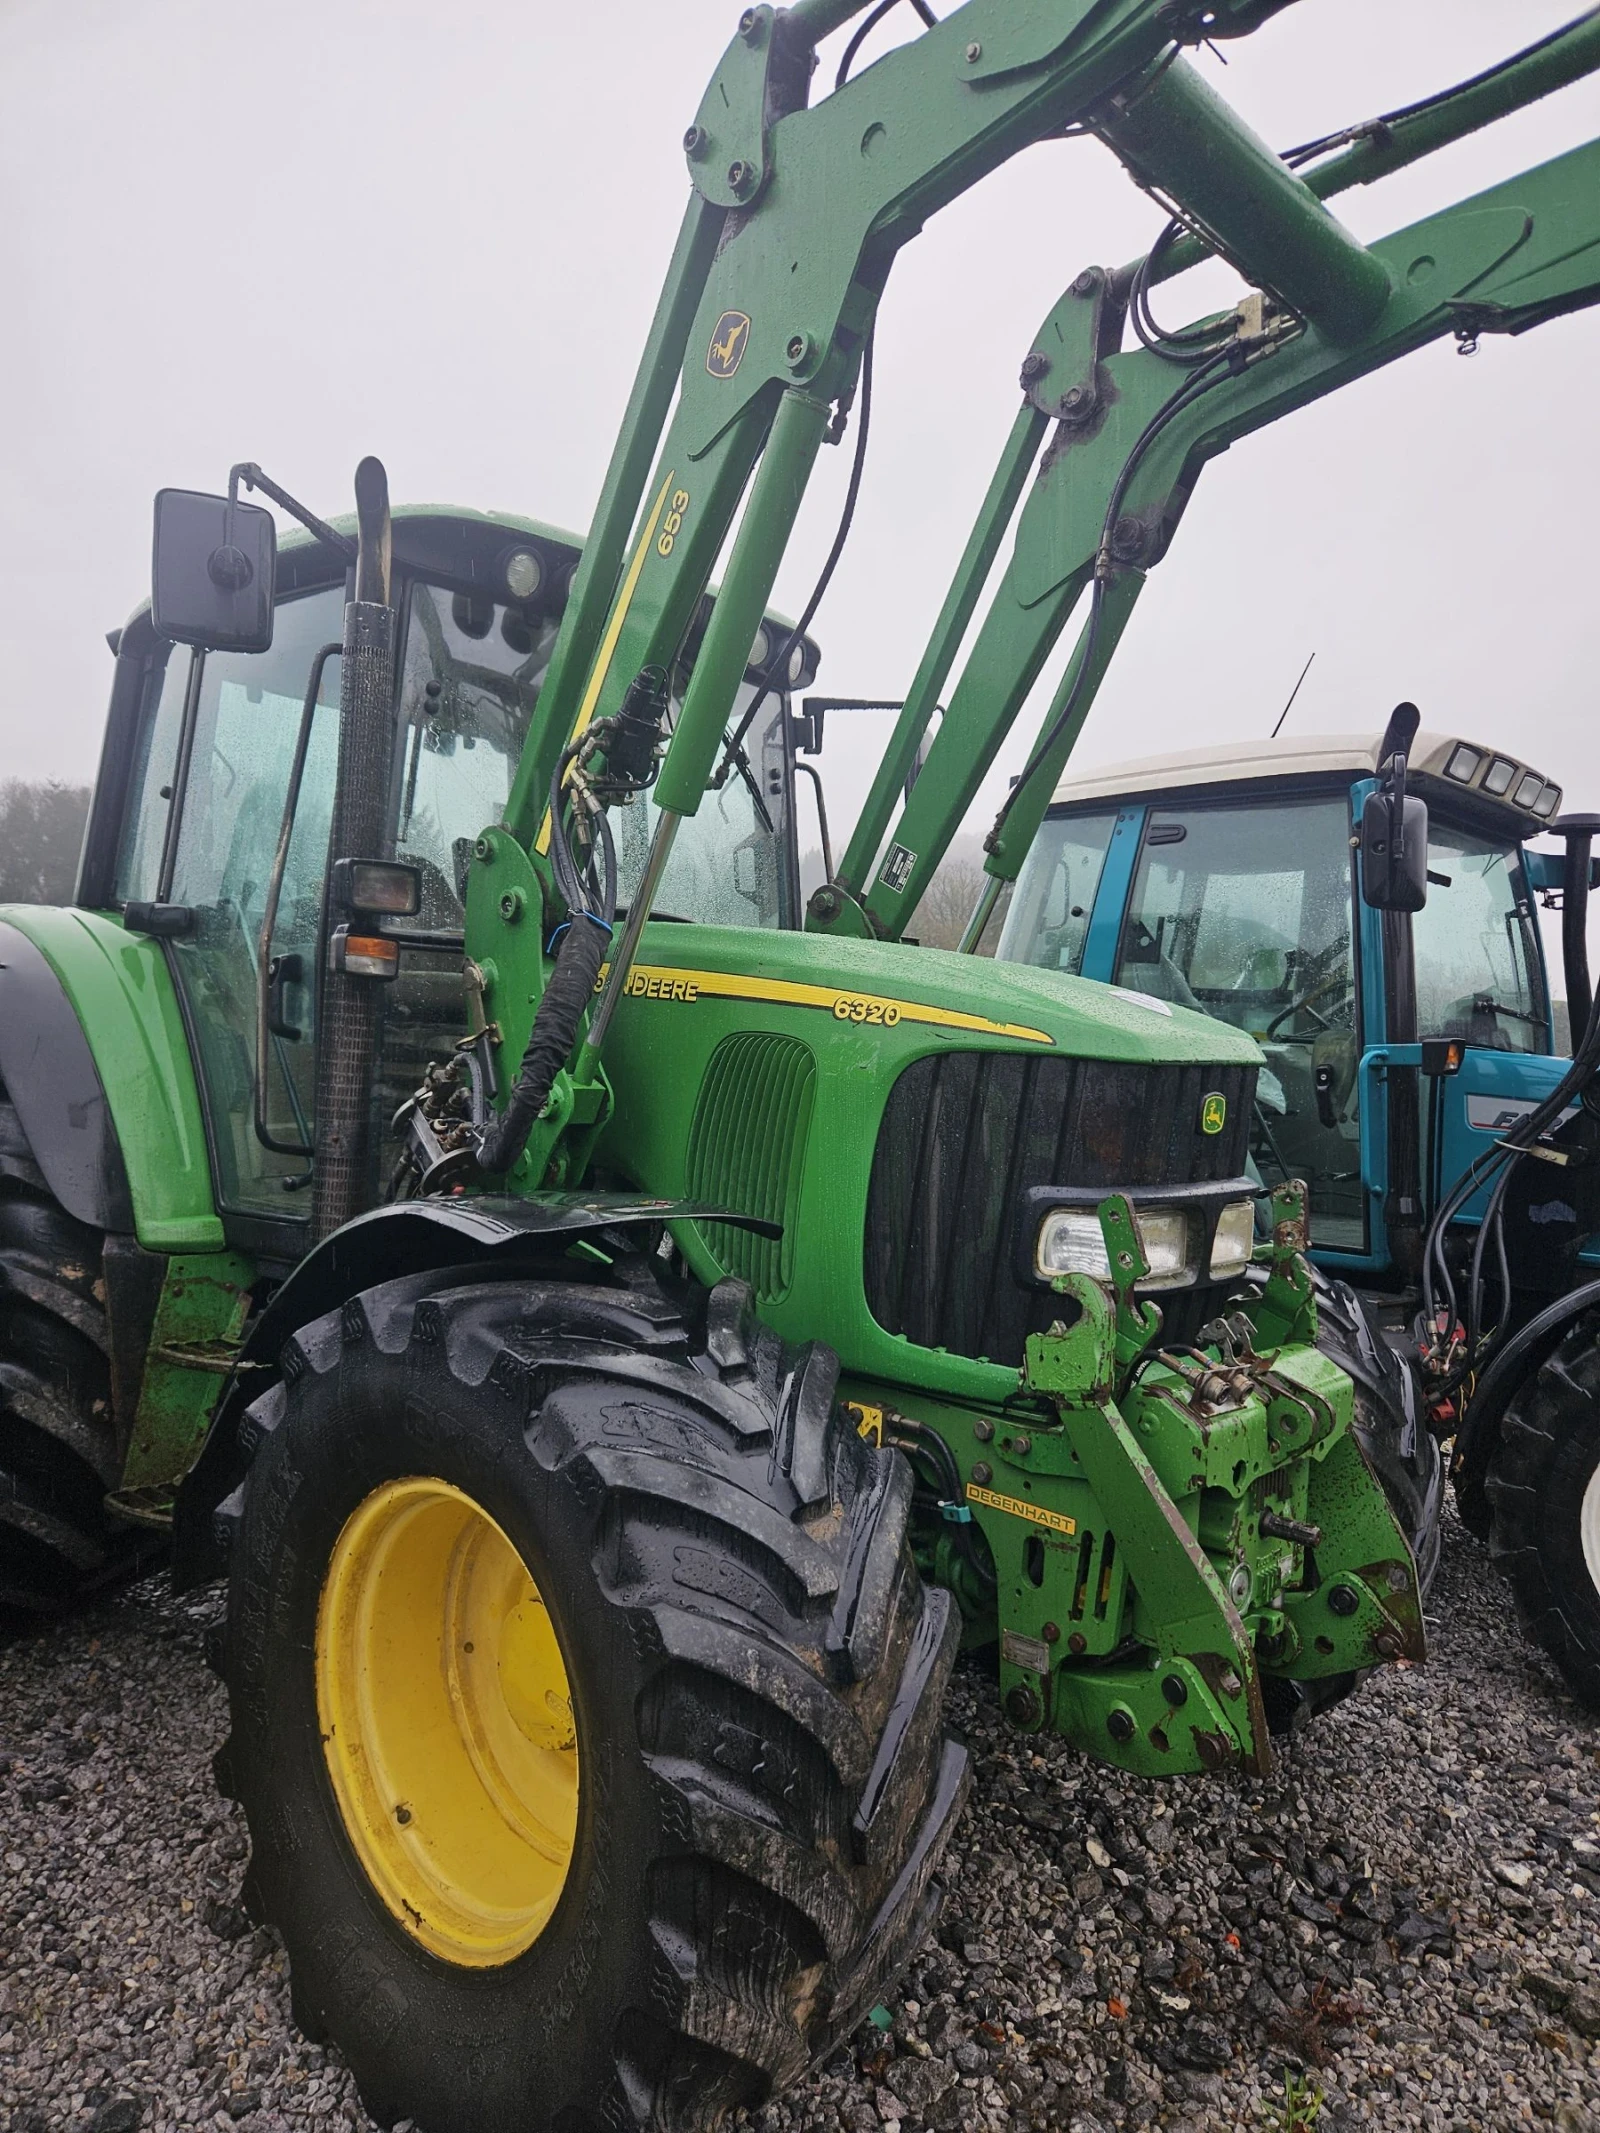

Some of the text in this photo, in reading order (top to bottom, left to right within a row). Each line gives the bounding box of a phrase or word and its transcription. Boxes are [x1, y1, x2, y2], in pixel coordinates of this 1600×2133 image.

[657, 489, 690, 556] 653
[631, 972, 700, 1002] DEERE
[834, 995, 901, 1027] 6320
[968, 1486, 1073, 1531] DEGENHART
